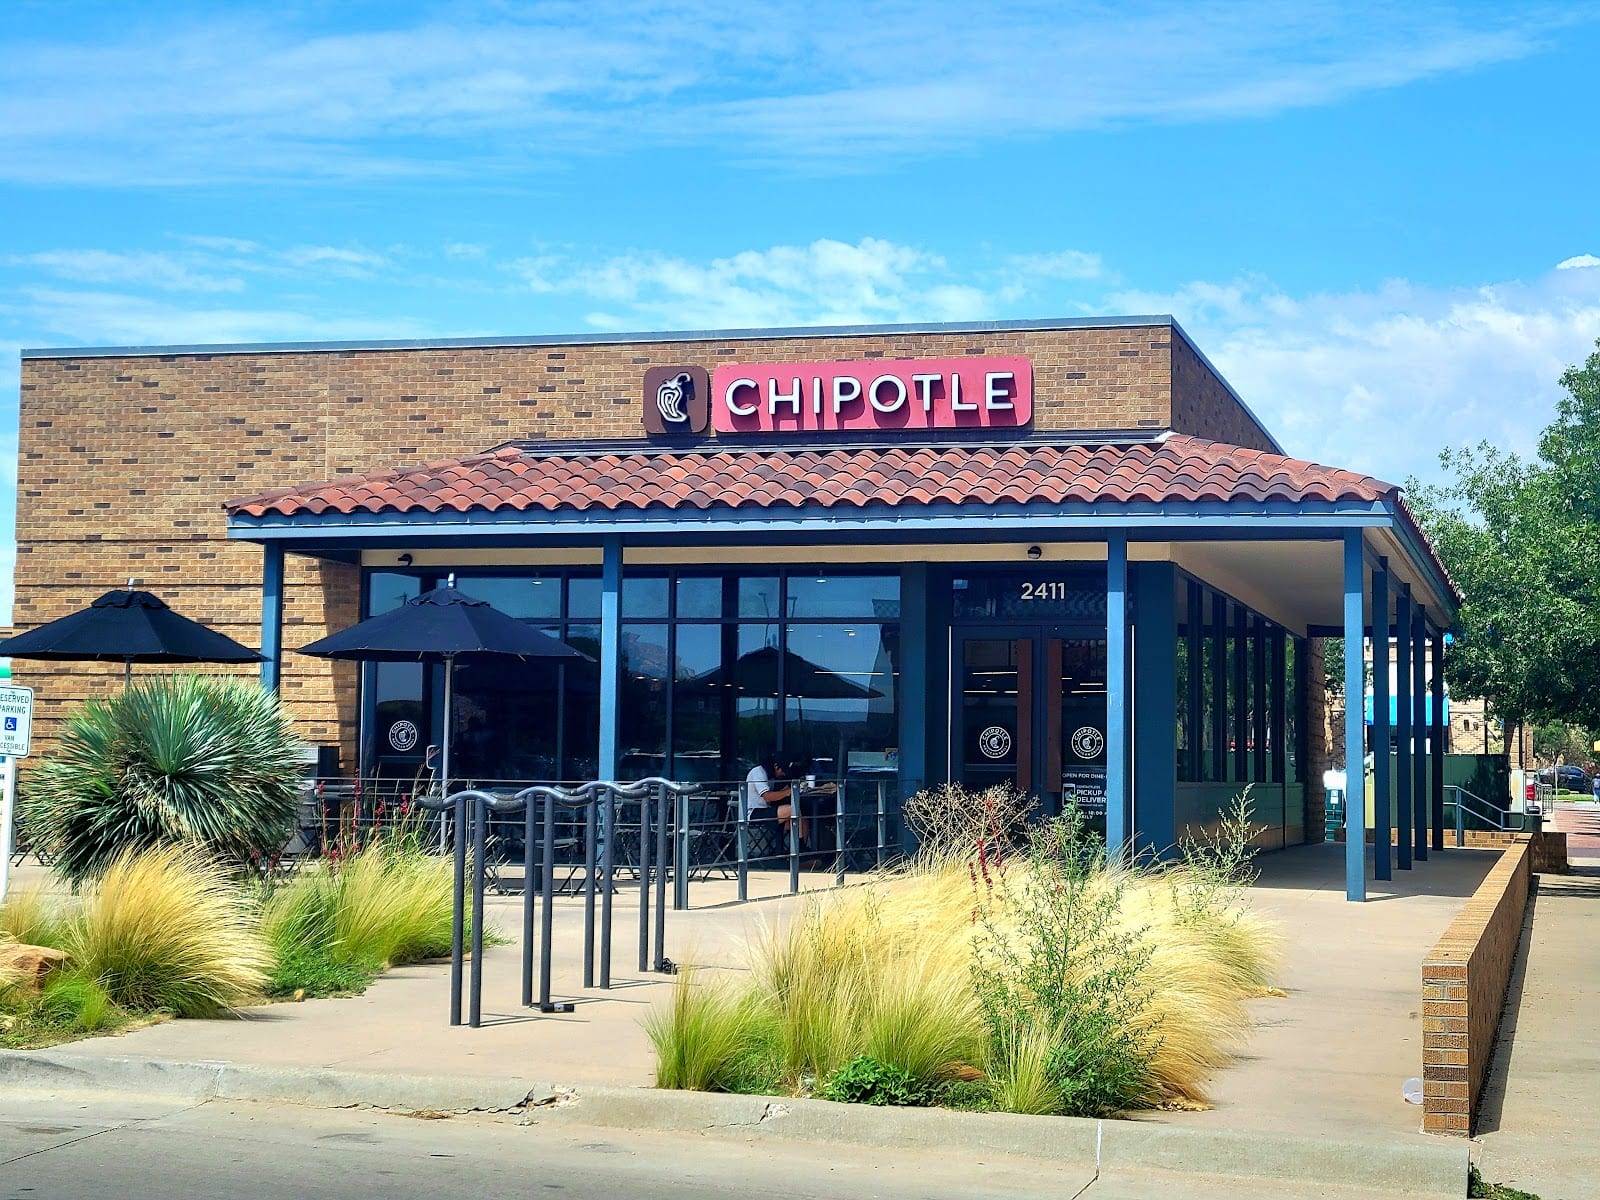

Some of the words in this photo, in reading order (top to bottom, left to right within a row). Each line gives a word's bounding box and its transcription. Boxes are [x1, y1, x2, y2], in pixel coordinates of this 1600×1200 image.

[725, 372, 1014, 416] CHIPOTLE
[1021, 583, 1065, 600] 2411
[0, 694, 29, 704] ESERVED
[391, 722, 414, 734] CHIPOTLE
[982, 728, 1009, 740] CHIPOTLE
[1074, 728, 1101, 741] CHIPOTLE
[0, 743, 25, 751] CESSIBLE
